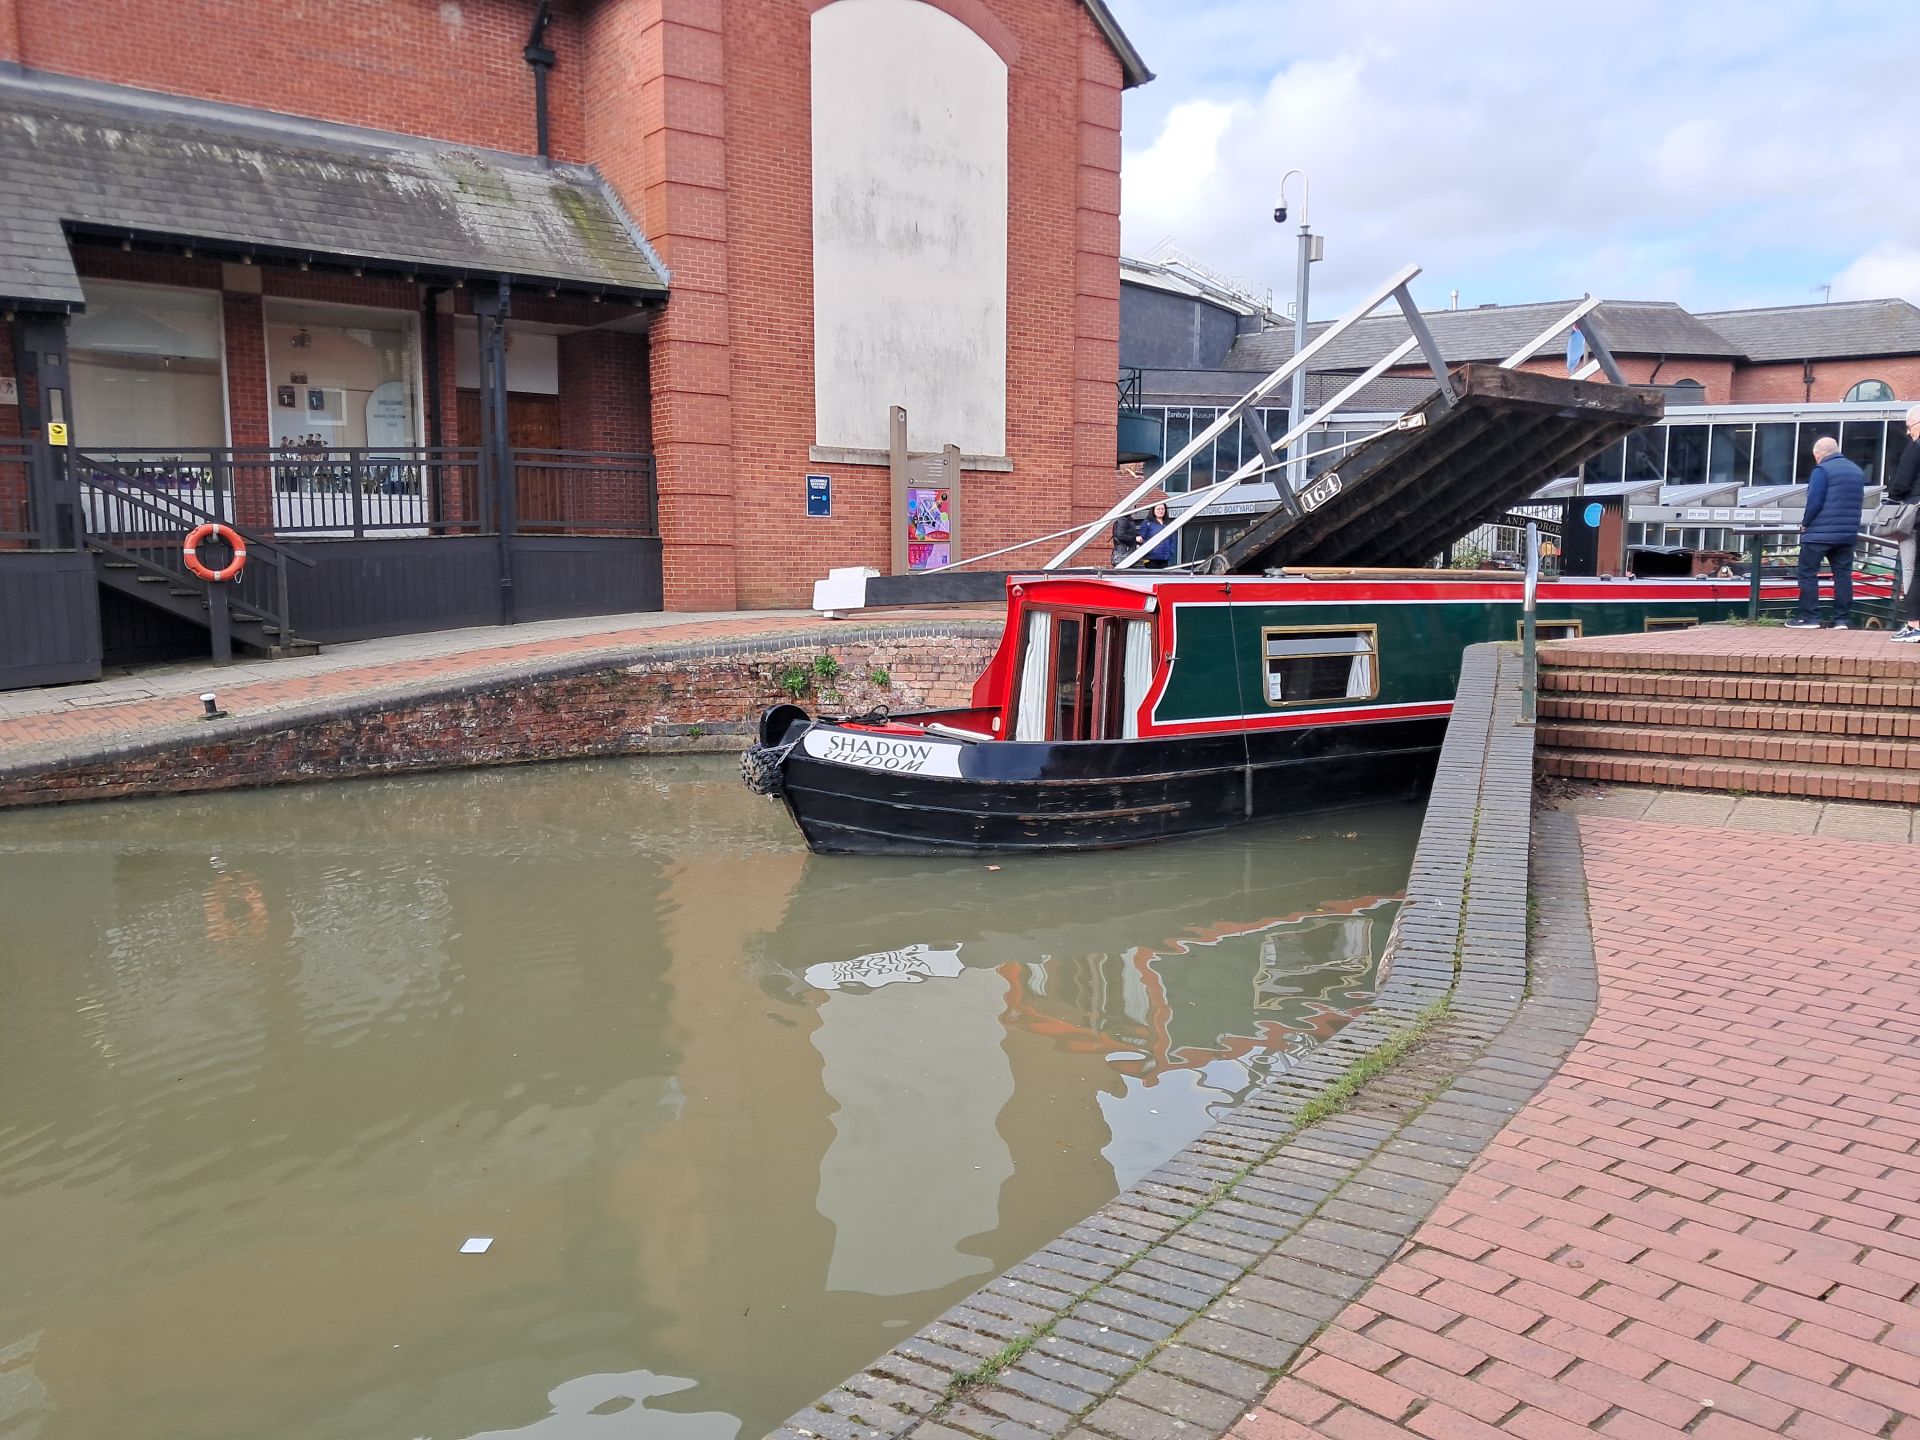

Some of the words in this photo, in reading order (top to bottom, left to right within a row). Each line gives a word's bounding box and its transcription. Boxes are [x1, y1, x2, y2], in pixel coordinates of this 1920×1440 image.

[1167, 411, 1190, 420] Banbury
[1192, 411, 1215, 419] Museum
[1305, 477, 1338, 509] 164
[1224, 504, 1254, 513] BOATYARD
[1505, 516, 1526, 526] AND
[829, 735, 933, 760] SHADOW
